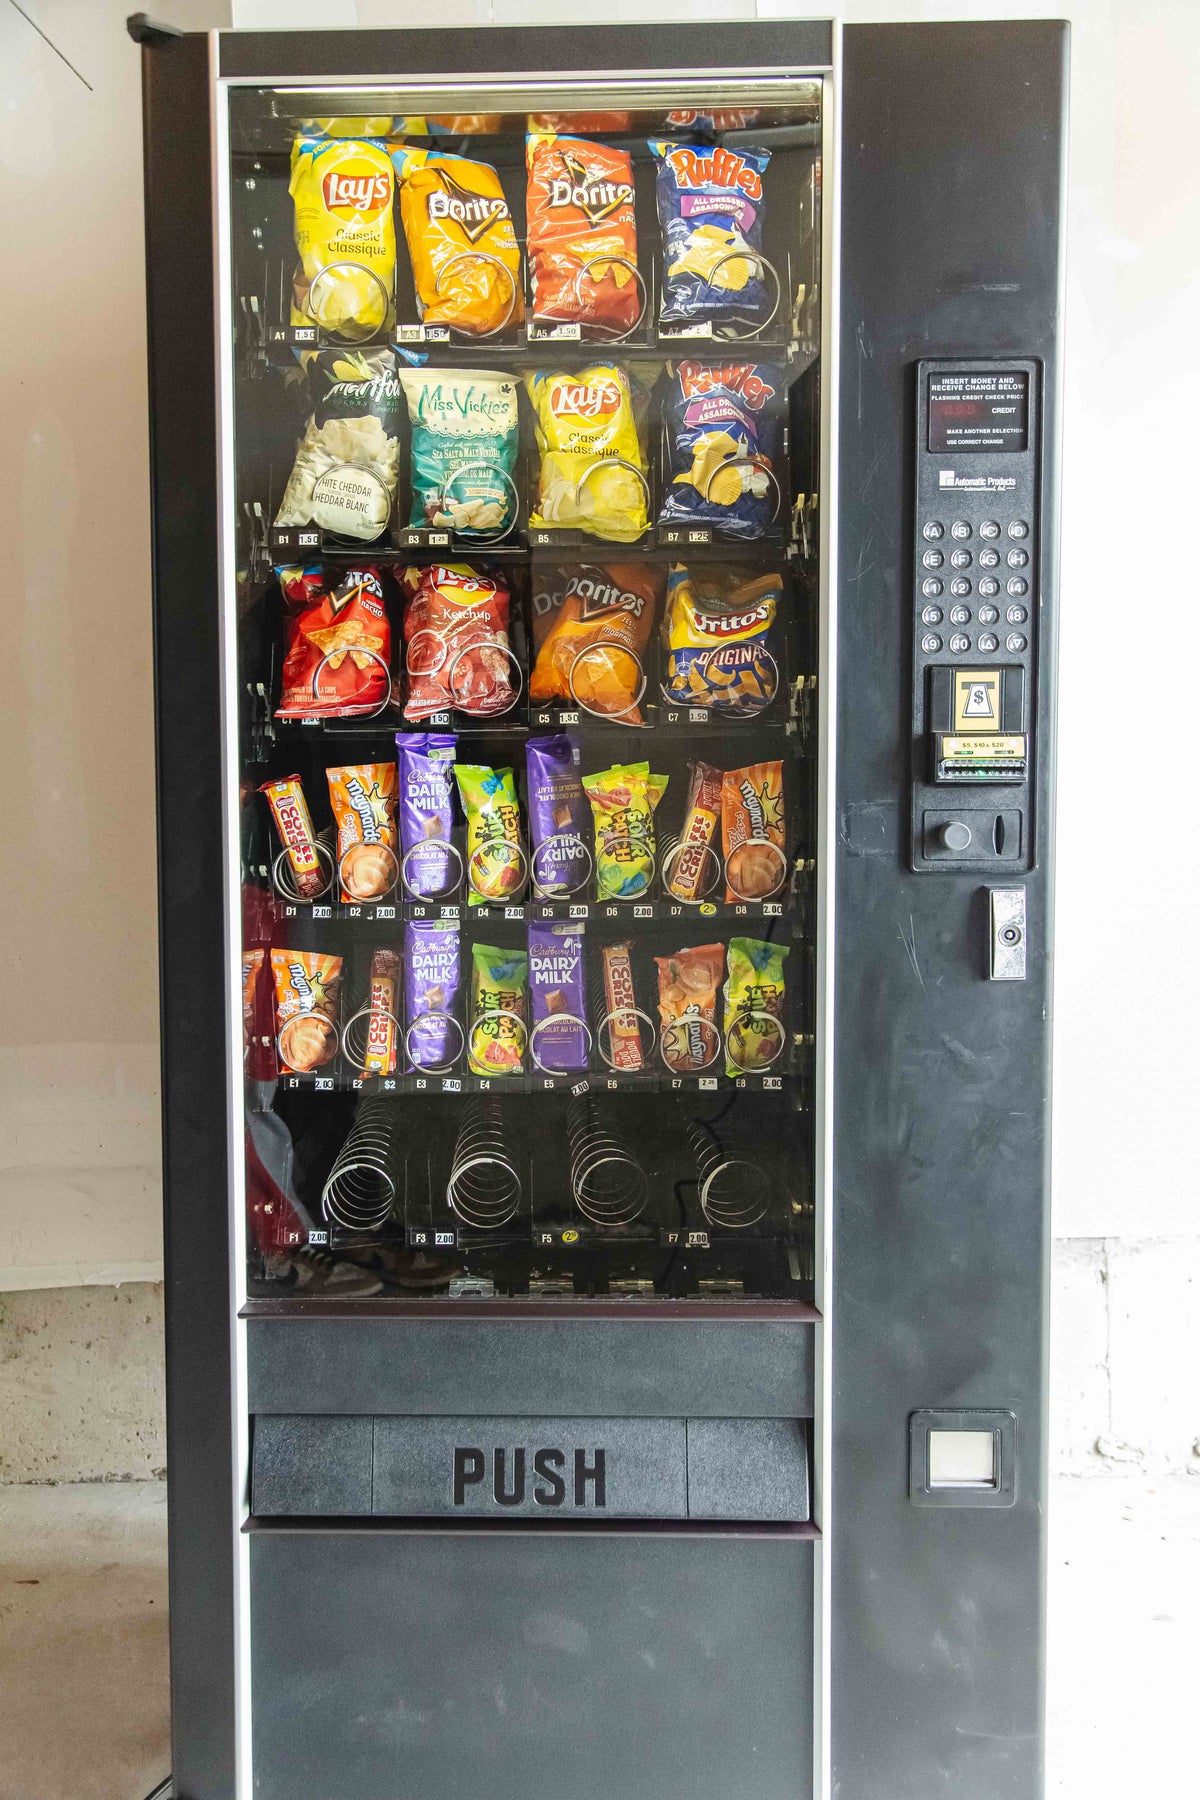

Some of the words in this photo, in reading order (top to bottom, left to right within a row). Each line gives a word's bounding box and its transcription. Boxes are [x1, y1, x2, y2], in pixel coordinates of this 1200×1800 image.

[669, 147, 762, 201] Ruffles
[329, 173, 388, 211] Lay's
[551, 180, 635, 206] Dorito
[430, 191, 511, 221] Dorito
[694, 197, 709, 205] ALL
[709, 197, 746, 208] DRESSED
[328, 241, 386, 258] Classique
[296, 331, 315, 339] 1.50
[405, 331, 417, 339] A3
[536, 329, 547, 337] A5
[559, 327, 576, 335] 1.50
[274, 332, 286, 340] A1
[418, 384, 453, 421] Miss
[453, 385, 510, 422] Vickie's
[553, 383, 618, 416] Lay's
[702, 402, 717, 411] ALL
[954, 477, 987, 486] Automatic
[987, 477, 1016, 486] Products
[319, 478, 337, 489] HITE
[339, 480, 372, 497] CHEDDAR
[314, 493, 344, 508] HEDDAR
[346, 497, 369, 514] BLANC
[930, 527, 939, 537] A
[958, 527, 967, 537] B
[986, 526, 996, 537] C
[1014, 526, 1023, 536] D
[279, 535, 289, 543] B1
[299, 535, 318, 543] 1.50
[408, 535, 419, 544] B3
[538, 534, 549, 543] B5
[668, 532, 679, 541] B7
[689, 532, 708, 540] 1.25
[930, 555, 938, 565] E
[958, 554, 967, 565] F
[986, 554, 996, 565] G
[1014, 554, 1023, 564] H
[346, 571, 383, 598] itos
[932, 584, 937, 594] 1
[958, 583, 966, 593] 2
[986, 583, 994, 593] 3
[1014, 583, 1022, 593] 4
[565, 577, 645, 617] Doritos
[443, 608, 491, 622] Ketchup
[929, 612, 938, 621] 5
[958, 611, 965, 621] 6
[986, 611, 994, 621] 7
[1014, 611, 1021, 621] 8
[929, 640, 937, 649] 9
[955, 640, 967, 649] 10
[539, 714, 550, 723] C5
[560, 713, 579, 723] 1.50
[668, 713, 679, 722] C7
[690, 713, 707, 721] 1.50
[408, 782, 453, 797] DAIRY
[412, 797, 450, 811] MILK
[739, 779, 770, 841] maynard
[280, 808, 302, 854] CRISP
[541, 845, 585, 863] DAIRY
[286, 907, 297, 915] D1
[314, 908, 331, 917] 2.00
[350, 908, 361, 916] D2
[378, 908, 394, 917] 2.00
[414, 907, 425, 916] D3
[441, 908, 459, 917] 2.00
[478, 907, 489, 916] D4
[507, 908, 524, 917] 2.00
[542, 907, 553, 916] D5
[570, 907, 587, 916] 2.00
[606, 907, 618, 916] D6
[635, 907, 652, 916] 2.00
[671, 906, 682, 915] D7
[735, 906, 747, 915] D8
[763, 905, 782, 914] 2.00
[412, 941, 450, 954] Cadbury
[530, 944, 570, 957] Cadbury
[412, 953, 458, 968] DAIRY
[530, 956, 579, 971] DAIRY
[416, 967, 452, 981] MILK
[535, 970, 574, 984] MILK
[620, 966, 637, 1029] COFFEE
[369, 984, 382, 1043] COFFEE
[482, 991, 500, 1035] SOUR
[289, 1079, 299, 1088] E1
[315, 1080, 334, 1089] 2.00
[353, 1080, 363, 1089] E2
[384, 1080, 396, 1089] $2
[416, 1079, 427, 1088] E3
[442, 1079, 460, 1090] 2.00
[480, 1080, 490, 1089] E4
[544, 1079, 554, 1088] E5
[607, 1080, 618, 1089] E6
[672, 1079, 682, 1088] E7
[736, 1079, 746, 1088] E8
[764, 1078, 781, 1088] 2.00
[572, 1081, 589, 1095] 2.00
[289, 1233, 299, 1242] F1
[311, 1233, 327, 1242] 2.00
[416, 1233, 426, 1242] F3
[437, 1234, 453, 1243] 2.00
[541, 1234, 552, 1243] F5
[668, 1233, 678, 1242] F7
[690, 1233, 707, 1243] 2.00
[452, 1447, 607, 1508] PUSH
